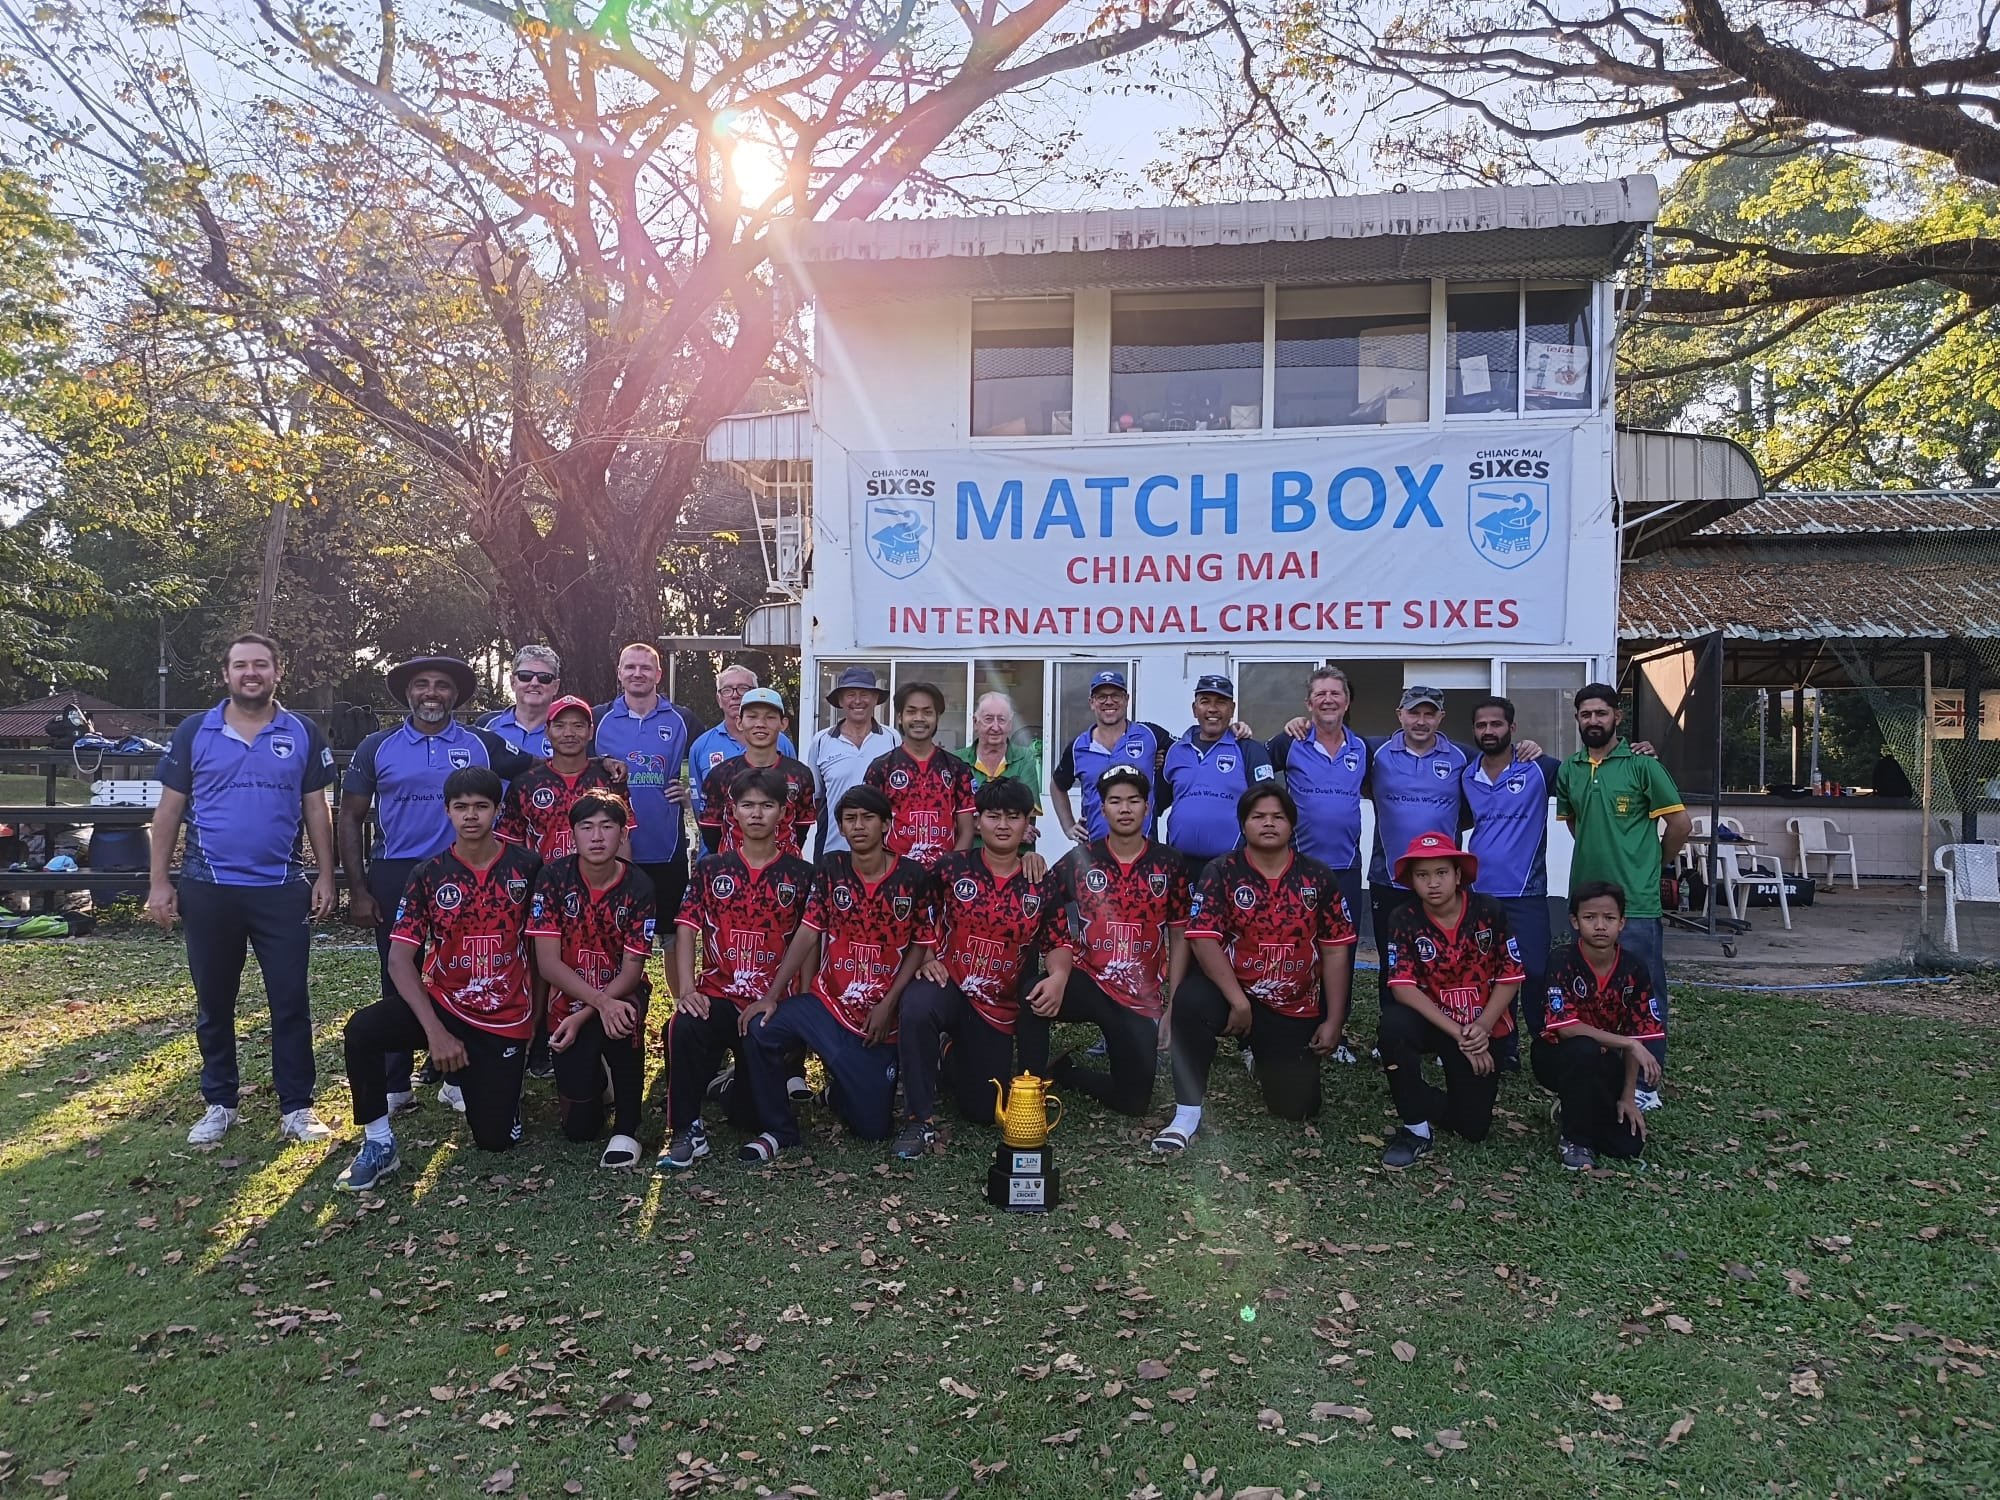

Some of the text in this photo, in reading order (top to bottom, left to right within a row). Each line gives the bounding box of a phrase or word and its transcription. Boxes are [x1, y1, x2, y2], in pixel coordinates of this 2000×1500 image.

[1476, 448, 1543, 459] CHIANG MAI
[871, 469, 929, 478] CHIANG MAI
[955, 463, 1448, 543] MATCH BOX
[1065, 551, 1320, 585] CHIANG MAI
[888, 599, 1520, 635] INTERNATIONAL CRICKET SIXES
[627, 772, 664, 784] LANNA
[1758, 885, 1796, 894] PLAER
